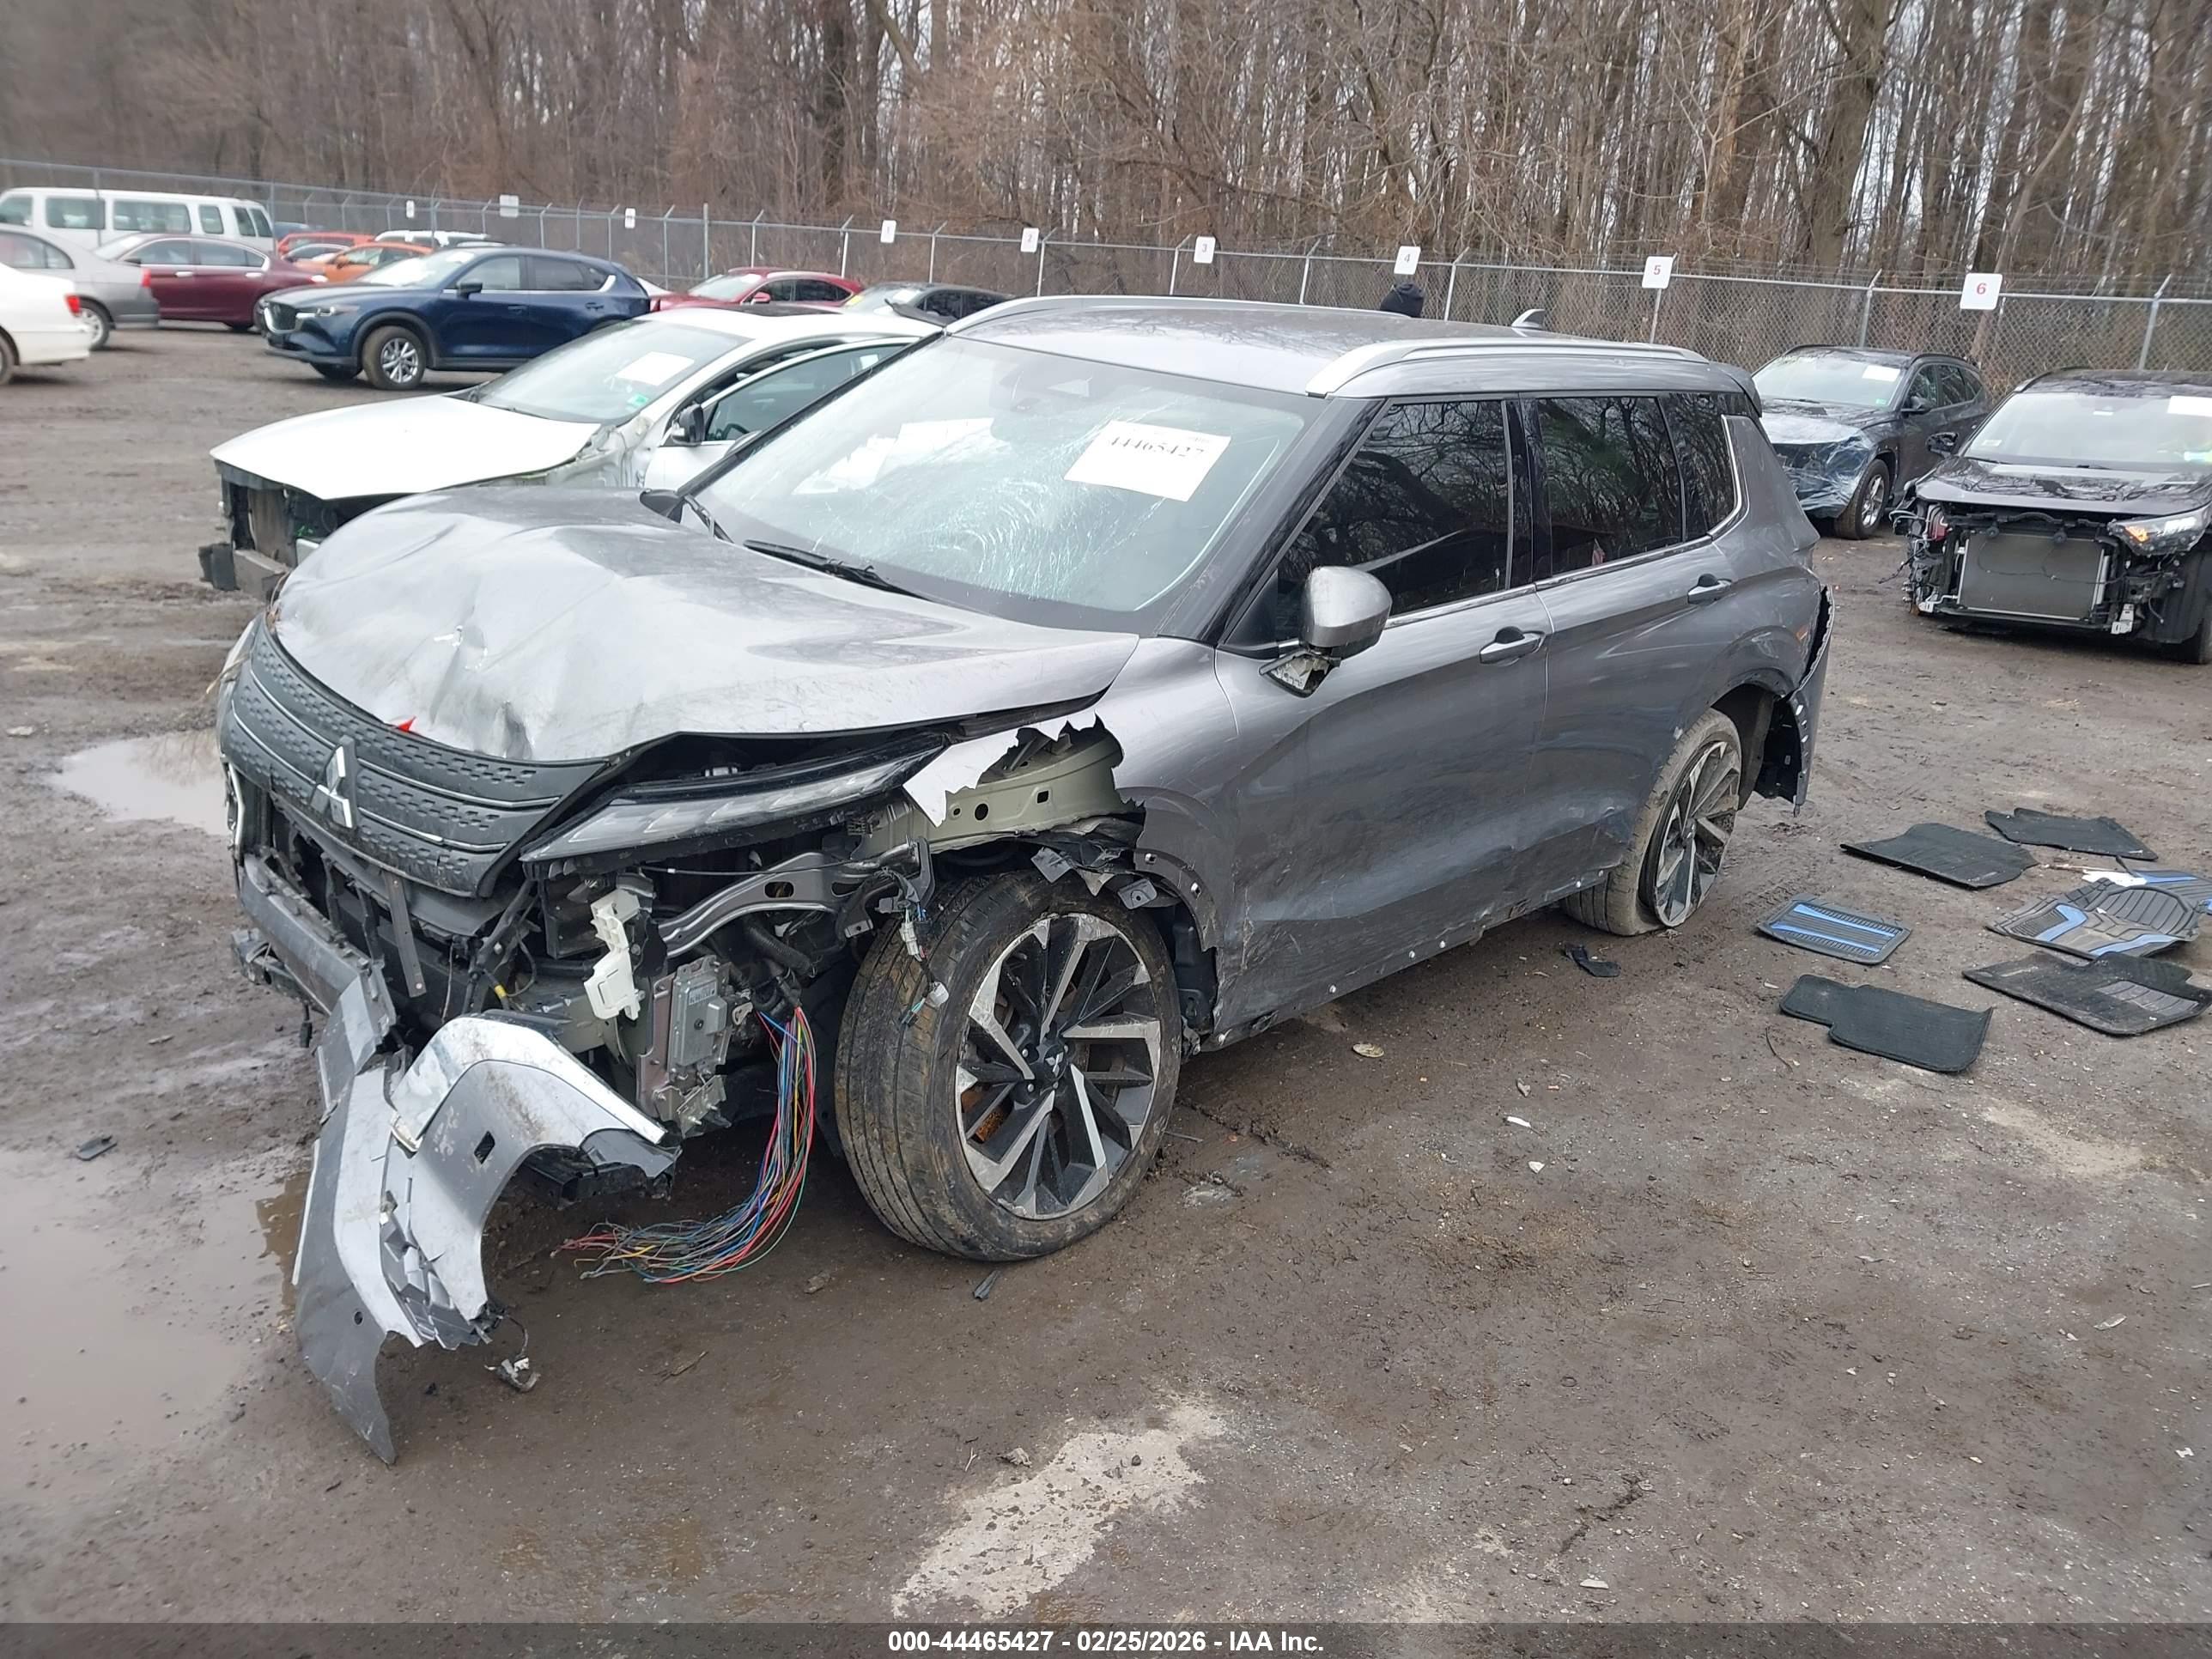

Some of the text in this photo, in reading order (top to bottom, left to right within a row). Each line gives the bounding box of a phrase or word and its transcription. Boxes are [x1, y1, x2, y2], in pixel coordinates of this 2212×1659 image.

[1201, 243, 1208, 252] 3
[1404, 253, 1411, 263] 4
[1653, 264, 1662, 275] 5
[1976, 282, 1987, 295] 6
